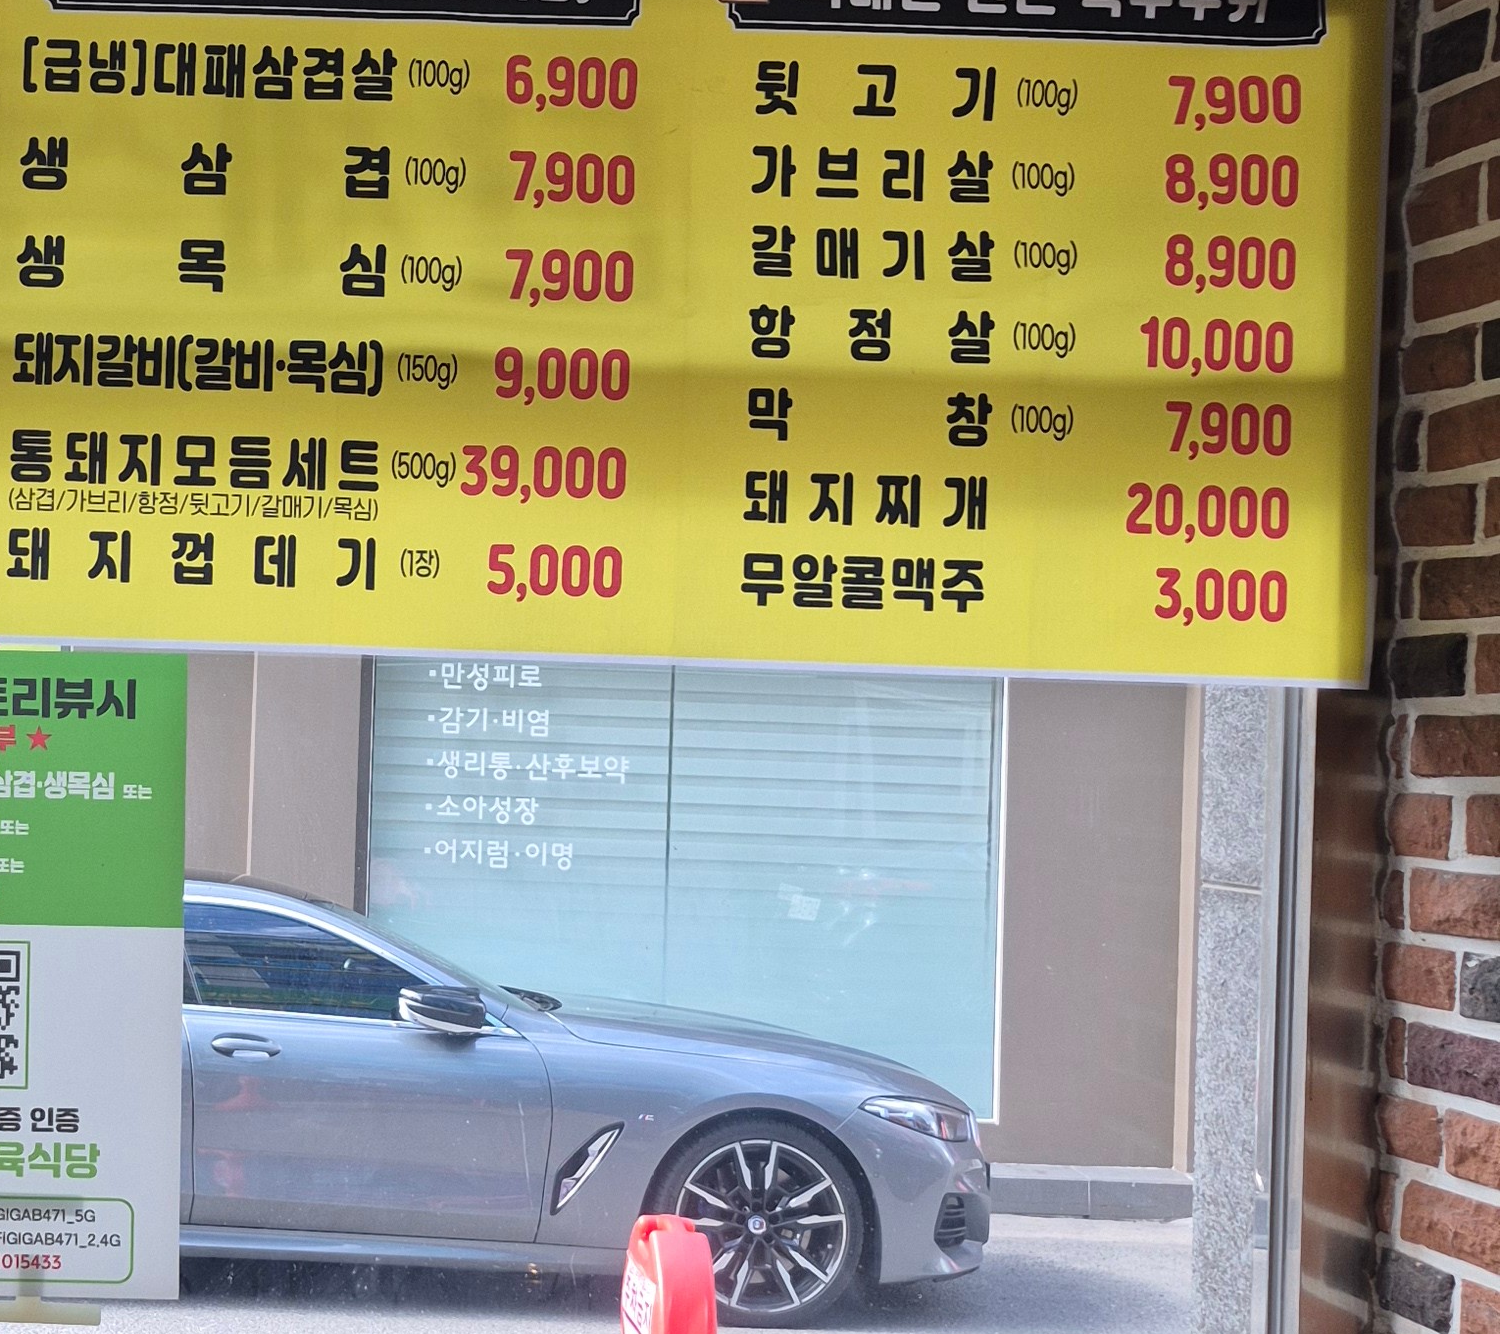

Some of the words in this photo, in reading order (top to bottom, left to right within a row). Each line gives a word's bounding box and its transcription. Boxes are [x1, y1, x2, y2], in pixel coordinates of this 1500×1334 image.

[408, 57, 470, 94] (100g)
[505, 55, 638, 112] 6,900
[1016, 78, 1078, 111] (100g)
[1168, 75, 1301, 131] 7,900
[405, 156, 466, 193] (100g)
[509, 151, 636, 209] 7,900
[1012, 161, 1075, 195] (100g)
[1166, 154, 1299, 210] 8,900
[400, 254, 463, 291] (100g)
[505, 249, 634, 307] 7,900
[1014, 241, 1078, 274] (100g)
[1166, 234, 1296, 295] 8,900
[1013, 321, 1076, 352] (100g)
[1141, 317, 1293, 376] 10,000
[397, 353, 458, 388] (150g)
[495, 347, 631, 405] 9,000
[1011, 405, 1074, 437] (100g)
[1166, 401, 1292, 459] 7,900
[10, 430, 379, 492] 통돼지모듬세트
[392, 448, 456, 487] (500g)
[461, 445, 627, 504] 39,000
[1126, 483, 1289, 543] 20,000
[400, 550, 439, 580] (1장)
[488, 544, 623, 603] 5,000
[741, 553, 984, 613] 무알콜맥주
[1155, 568, 1288, 626] 3,000
[123, 785, 152, 800] 또는
[436, 794, 539, 825] 소아성장
[0, 820, 29, 836] 또는
[29, 1107, 80, 1133] 인증
